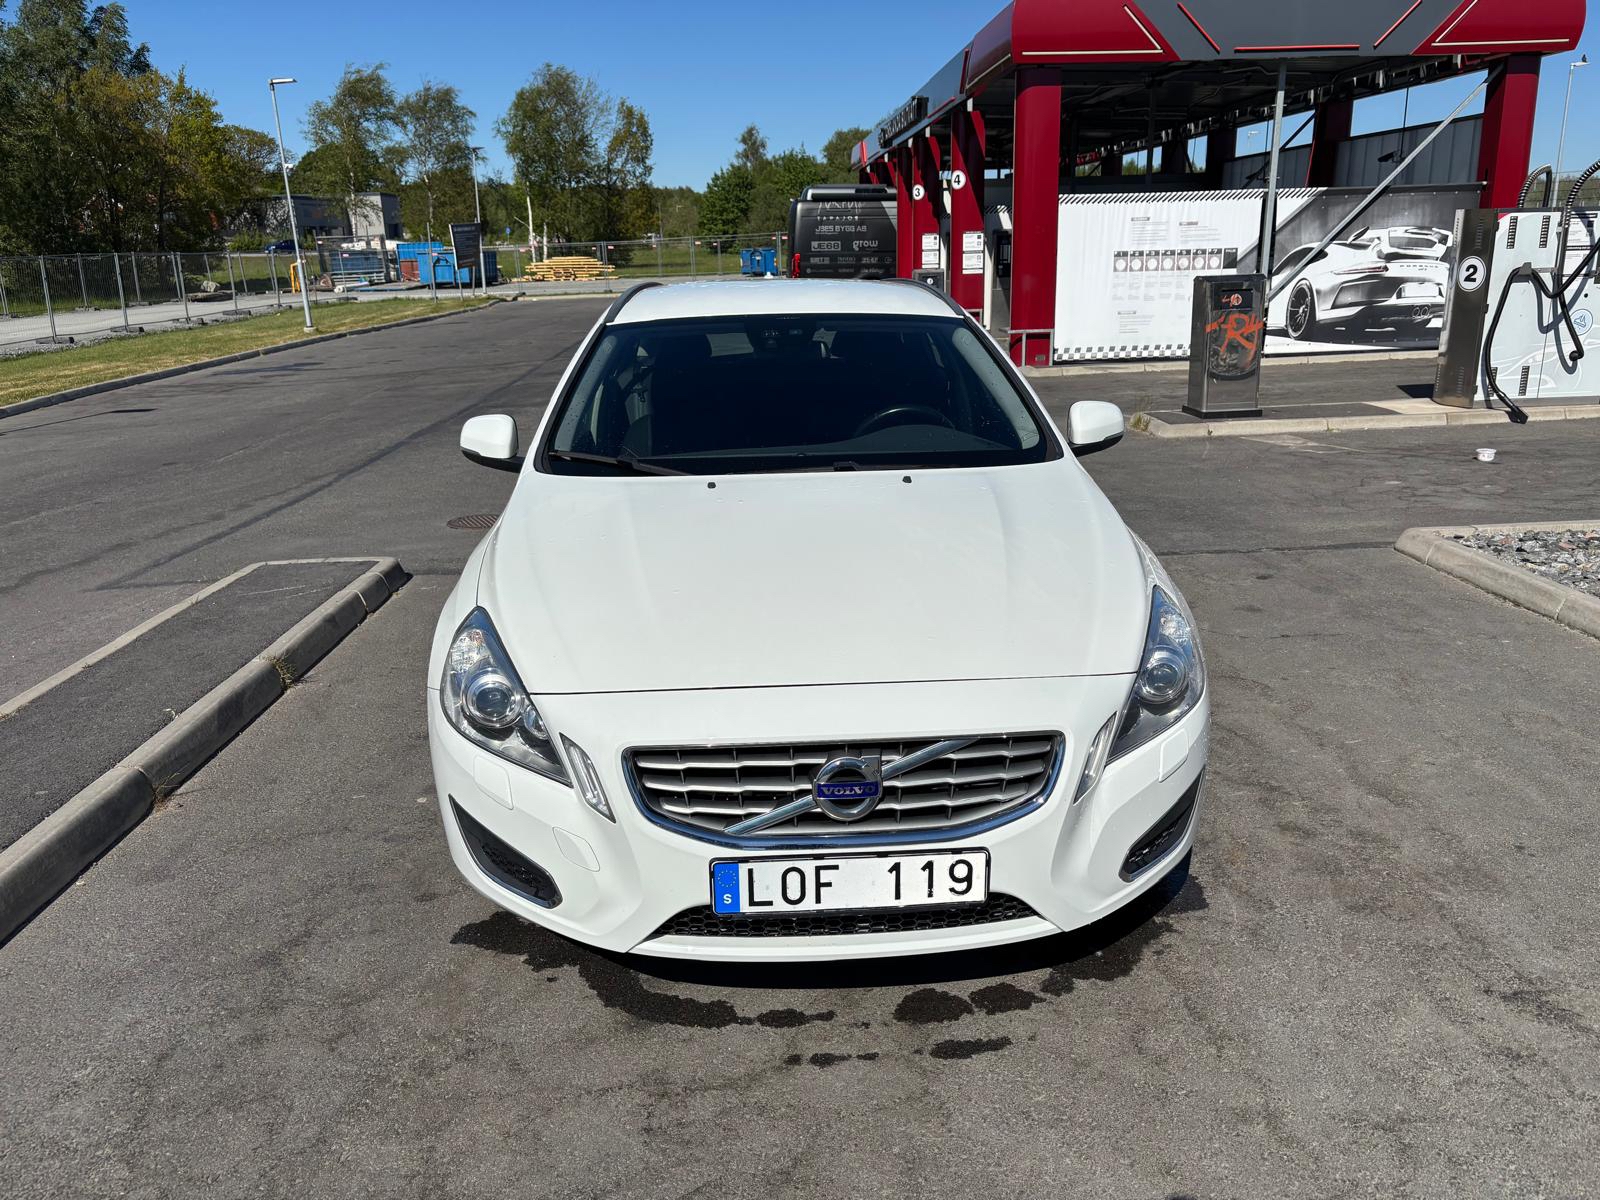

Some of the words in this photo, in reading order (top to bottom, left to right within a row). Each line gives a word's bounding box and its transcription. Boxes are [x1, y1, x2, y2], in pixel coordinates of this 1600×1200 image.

[953, 174, 961, 186] 4
[914, 188, 921, 197] 3
[853, 240, 878, 251] grow
[1464, 264, 1478, 283] 2
[821, 784, 877, 795] VOLVO
[747, 864, 840, 907] LOF
[887, 858, 974, 901] 119
[723, 893, 732, 904] S
